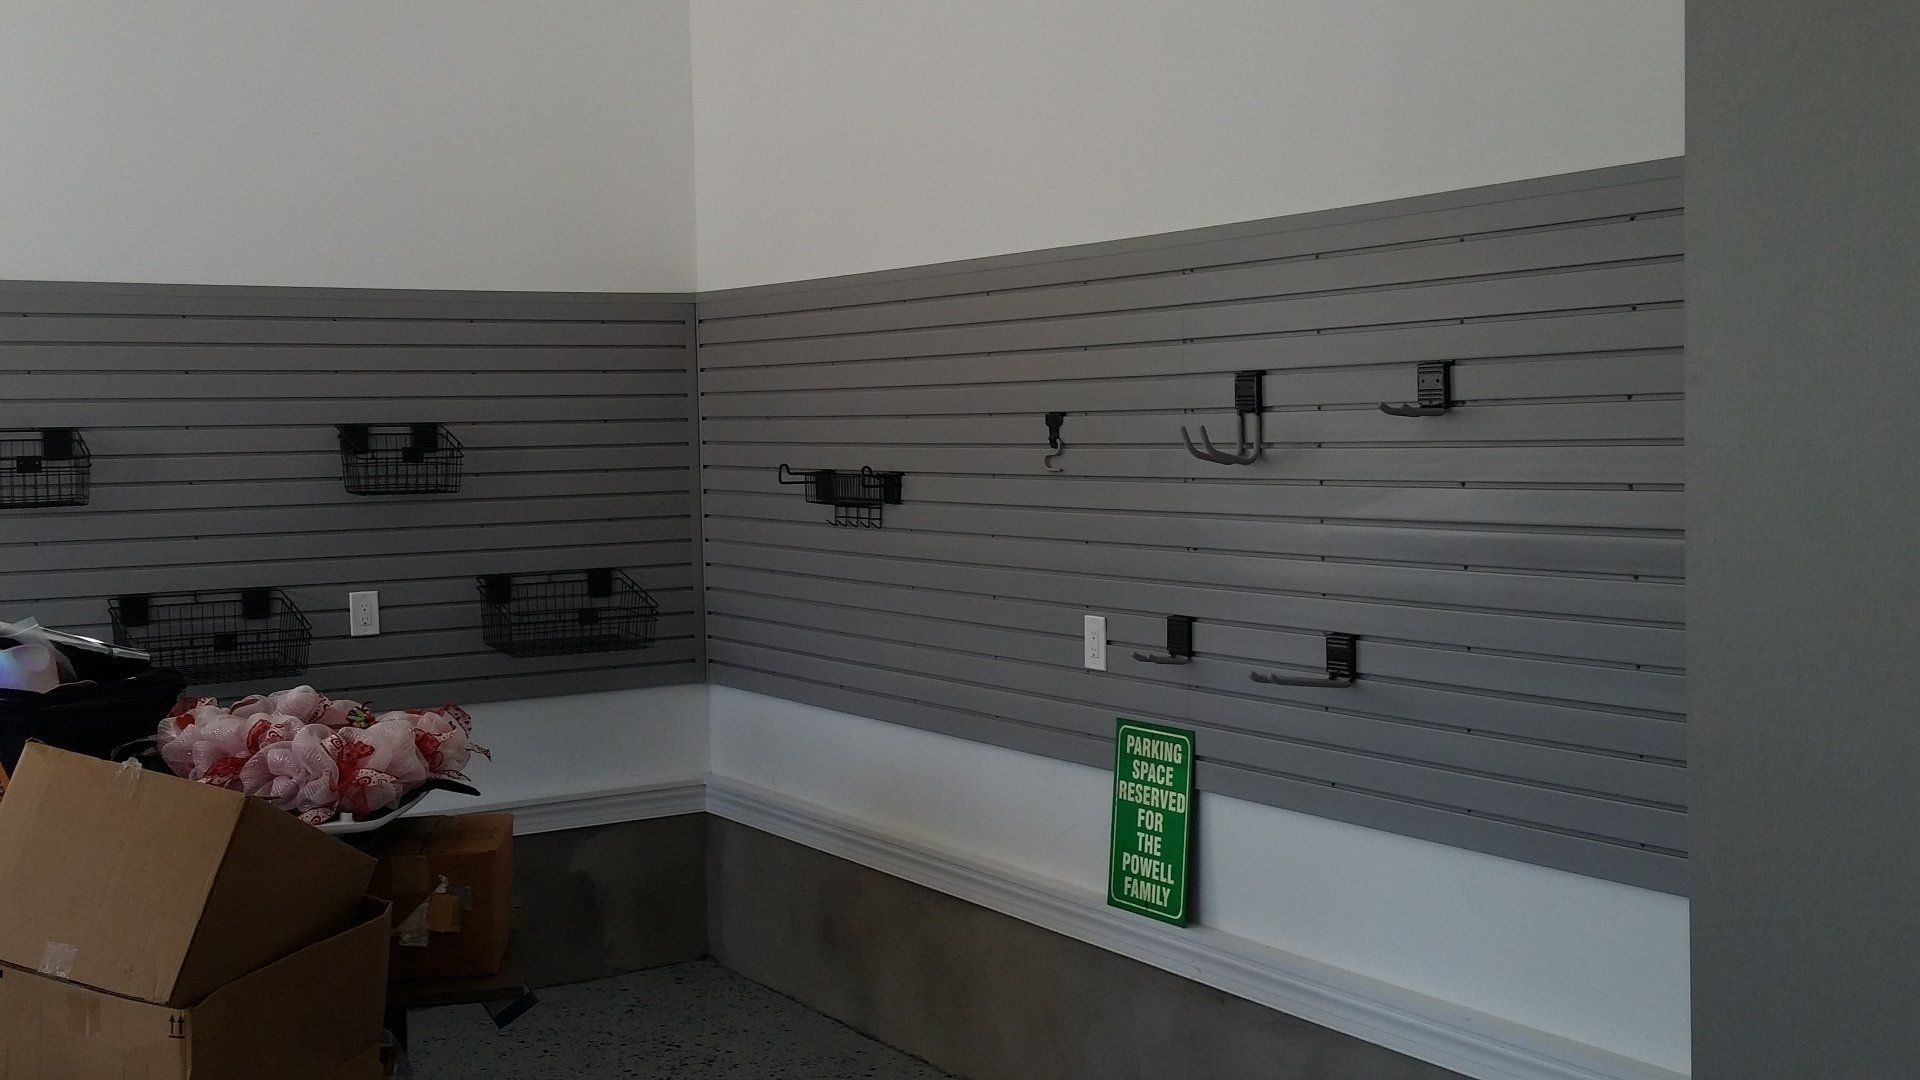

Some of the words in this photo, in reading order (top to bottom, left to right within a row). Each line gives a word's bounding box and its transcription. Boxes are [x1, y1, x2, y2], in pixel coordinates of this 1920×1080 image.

[1126, 734, 1182, 764] PARKING
[1132, 759, 1174, 787] SPACE
[1118, 780, 1186, 814] RESERVED
[1137, 808, 1164, 832] FOR
[1137, 832, 1162, 856] THE
[1122, 852, 1175, 885] POWELL
[1123, 876, 1171, 908] FAMILY
